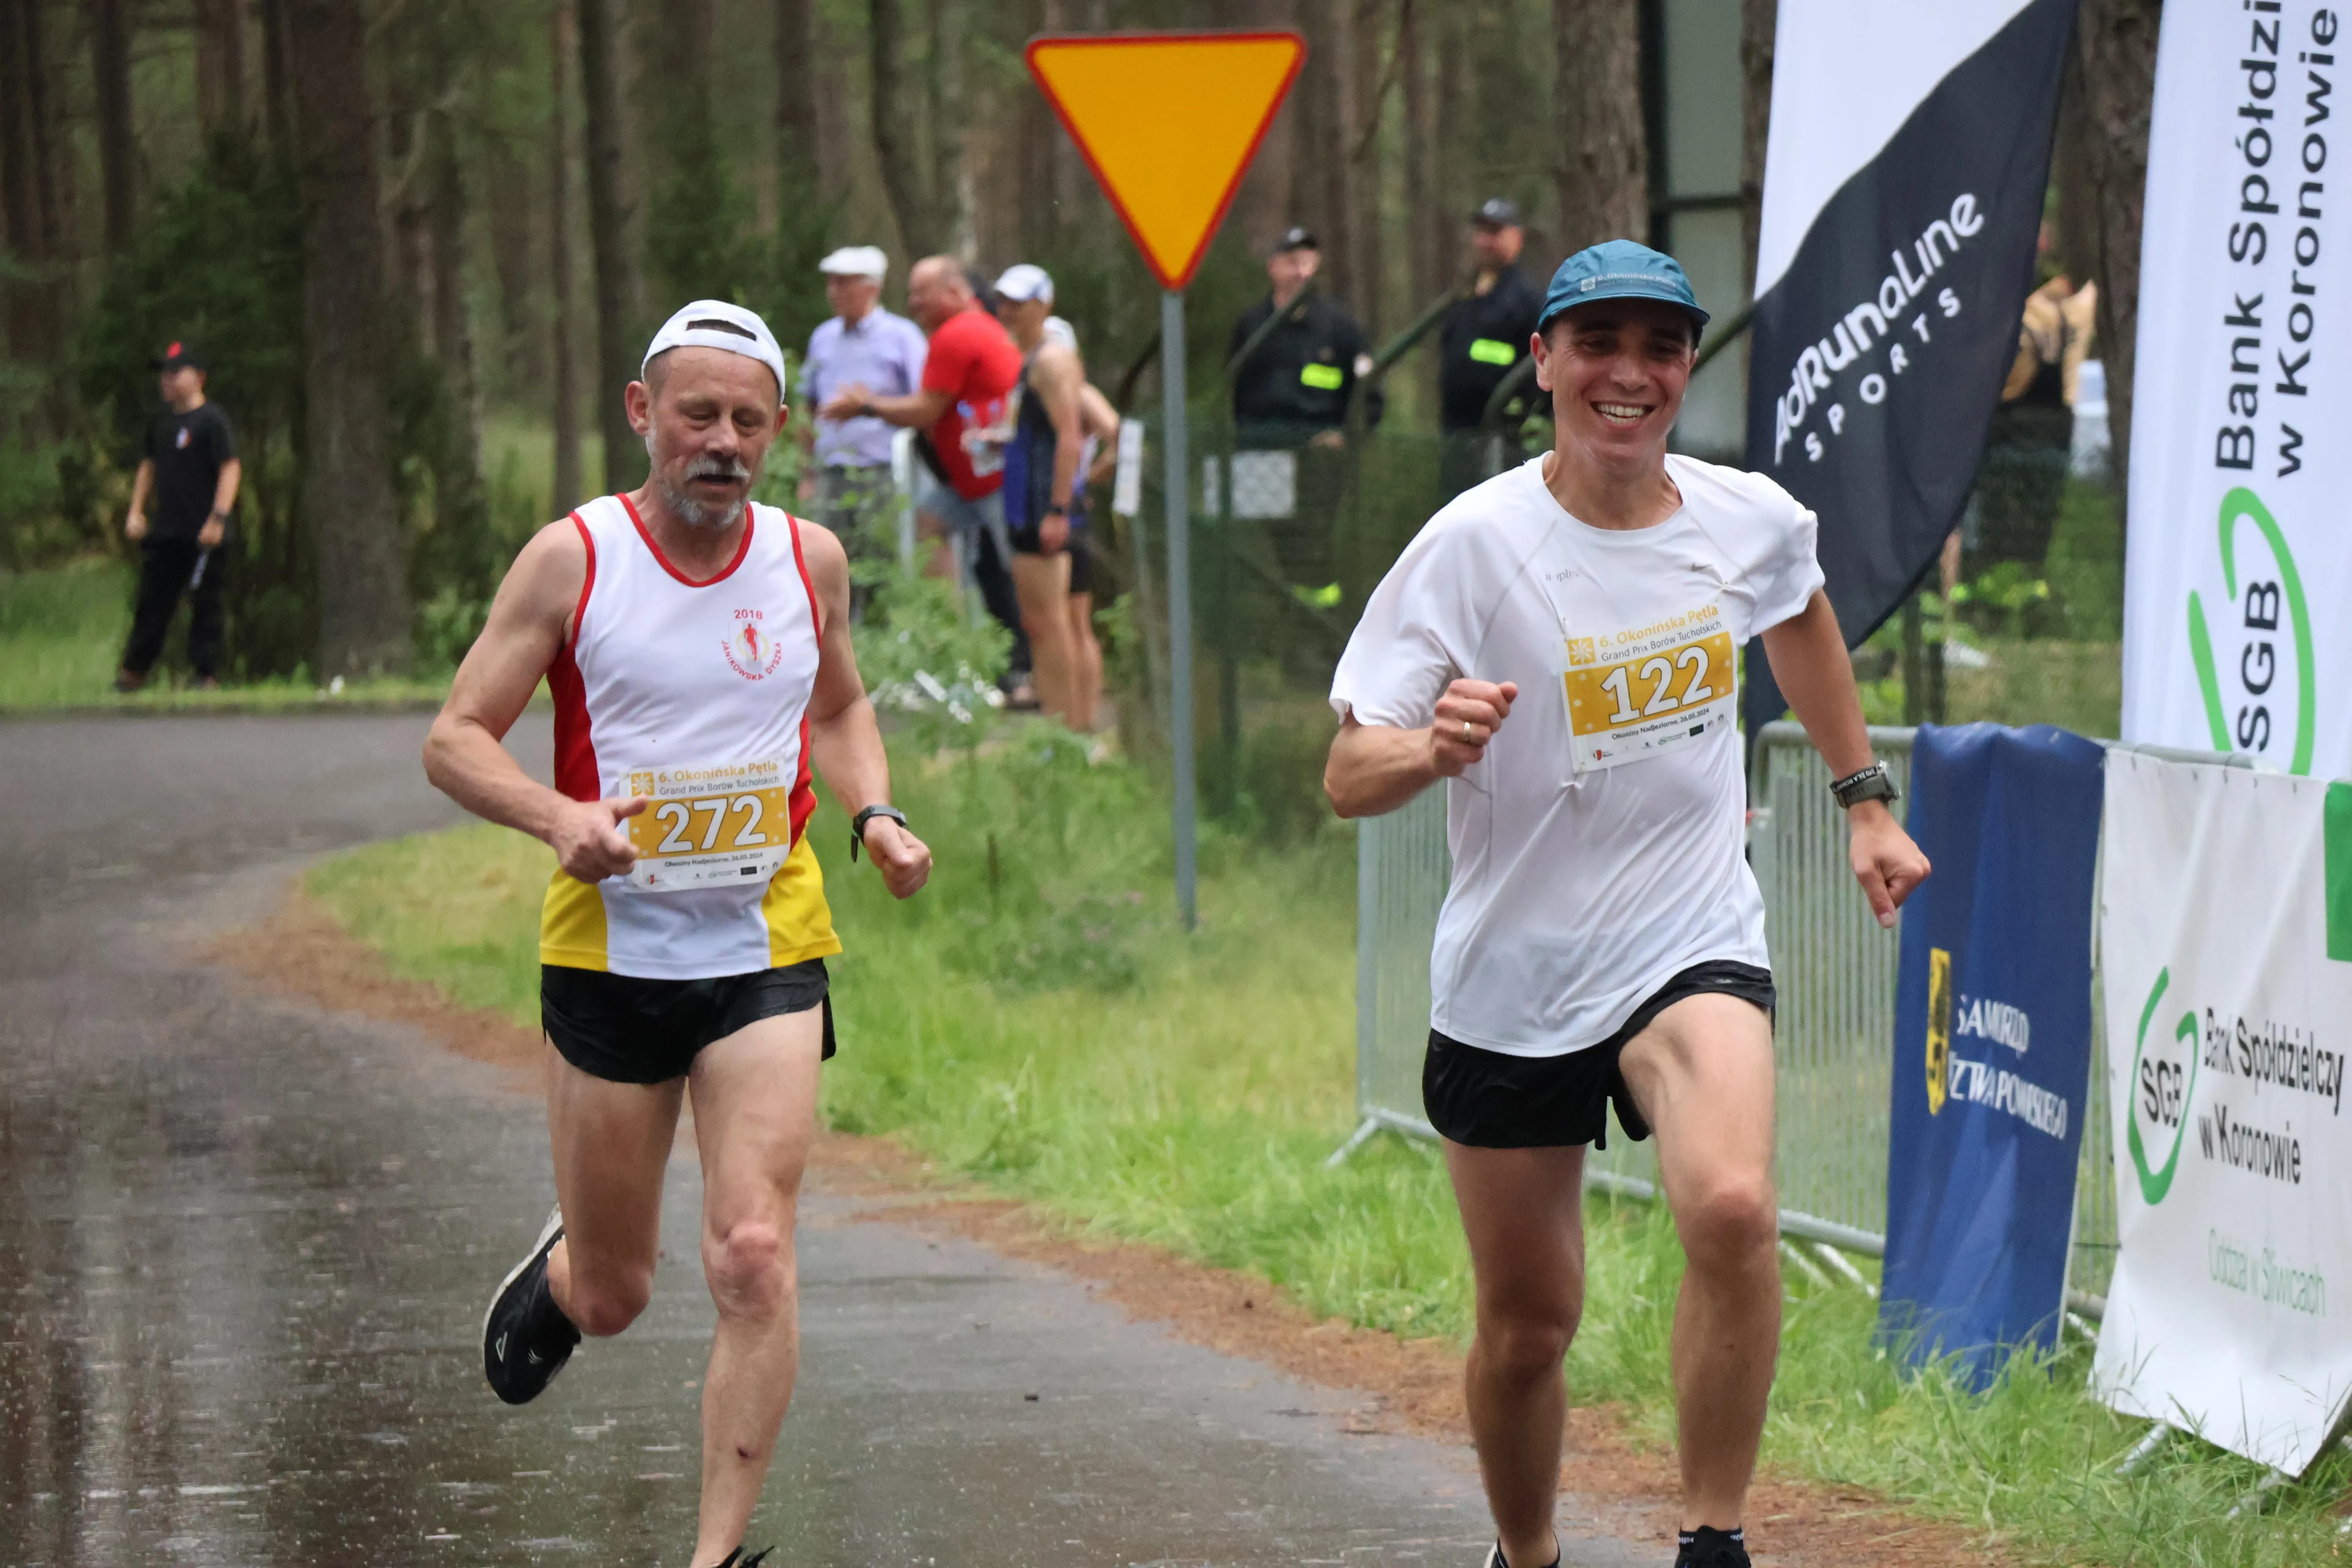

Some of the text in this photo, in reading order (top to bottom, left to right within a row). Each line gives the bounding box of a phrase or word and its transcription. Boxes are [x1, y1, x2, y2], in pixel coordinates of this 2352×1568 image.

[2275, 9, 2337, 477] w Koronowie
[1805, 288, 1961, 462] SPORTS
[2214, 292, 2263, 470] Bank
[734, 609, 762, 619] 2018
[1600, 605, 1718, 647] 6. Okonińska Pętla
[1601, 621, 1722, 661] Grand Prix Borów Tucholskich
[722, 640, 781, 680] JANIKOWSKA DYSZKA
[1600, 646, 1712, 724] 122
[2237, 581, 2280, 752] SGB
[659, 761, 777, 782] 6. Okonińska Pętla
[660, 784, 686, 795] Grand
[708, 781, 732, 791] Borów
[737, 775, 779, 787] Tucholskich
[656, 795, 767, 853] 272
[2141, 1057, 2182, 1127] SGB
[2204, 1007, 2344, 1115] Bank Spółdzielczy
[2198, 1103, 2300, 1184] w Koronowie
